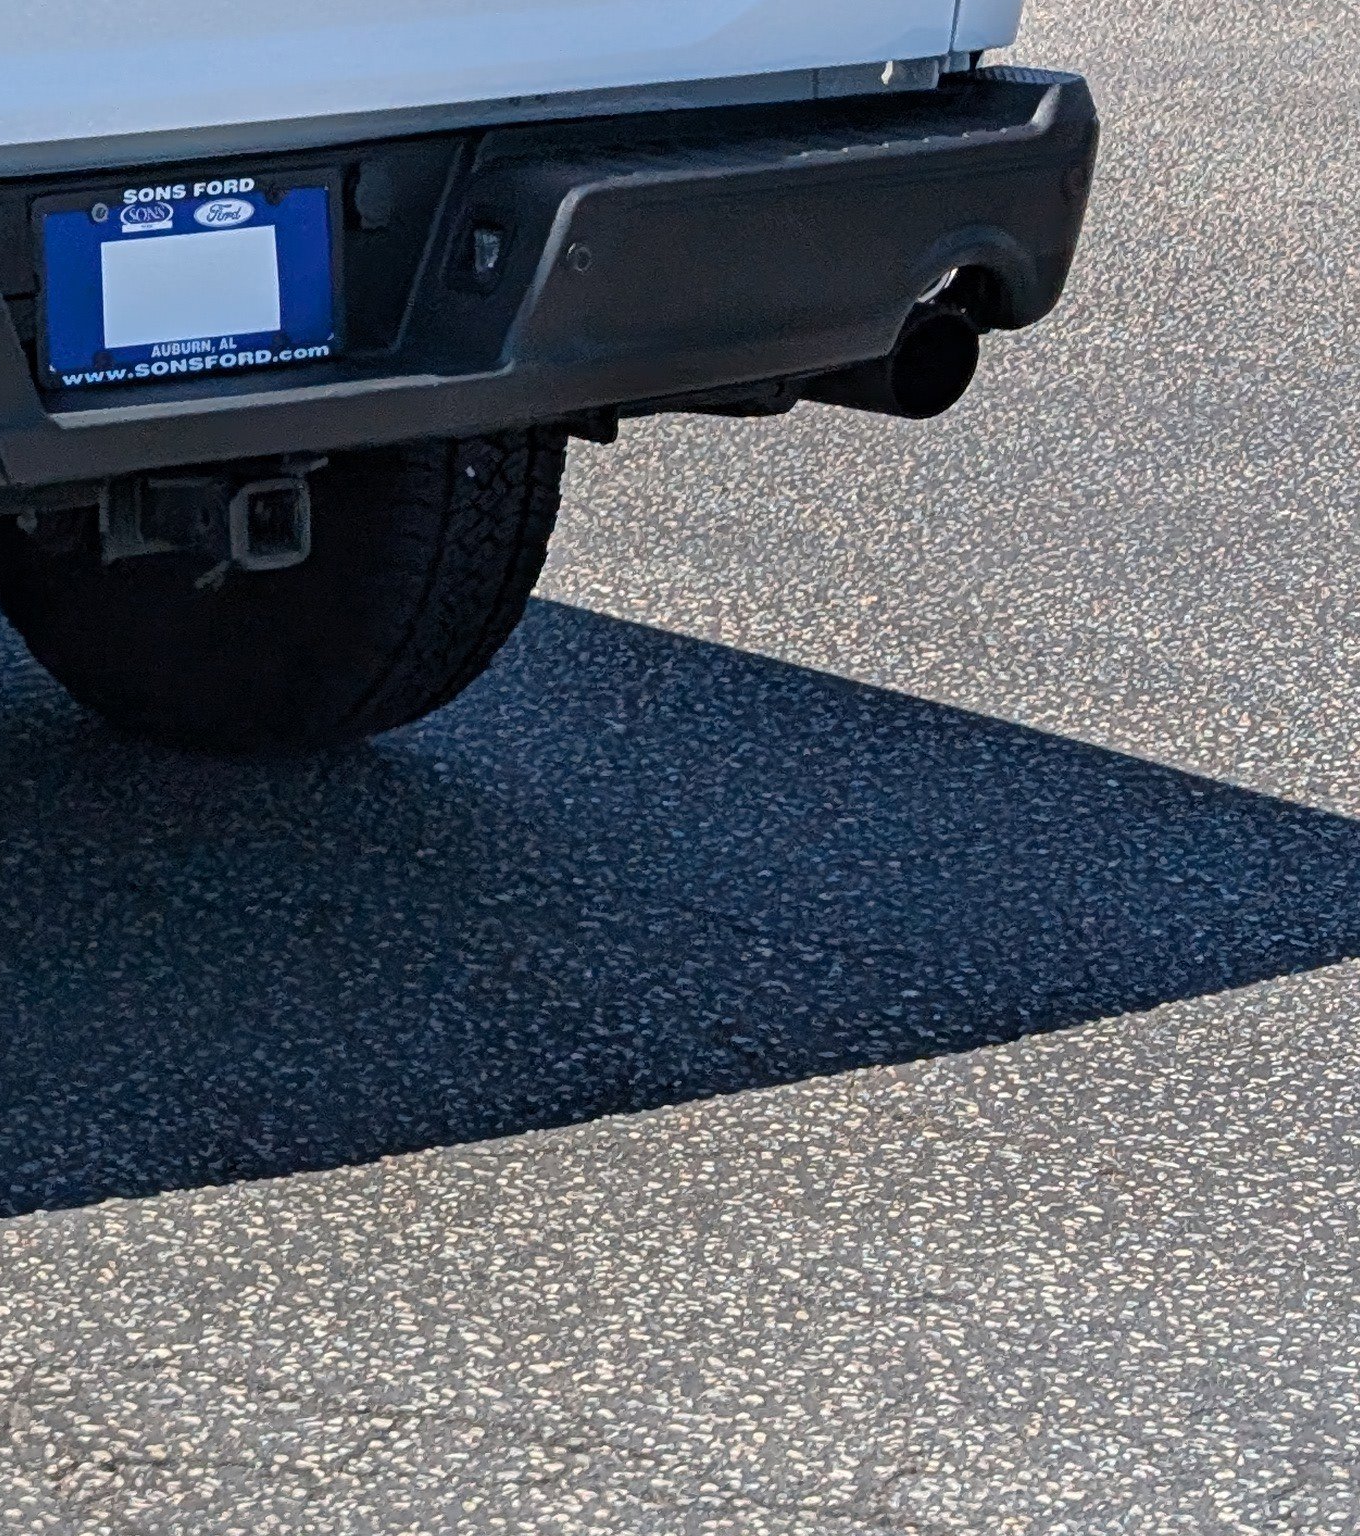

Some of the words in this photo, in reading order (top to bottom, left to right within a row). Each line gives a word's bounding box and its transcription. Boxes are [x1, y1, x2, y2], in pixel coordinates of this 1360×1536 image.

[123, 183, 186, 204] SONS
[193, 177, 255, 197] FORD
[129, 204, 166, 223] SONS
[206, 204, 242, 222] Ford
[152, 339, 215, 358] AUBURN,
[219, 337, 237, 350] AL
[62, 345, 330, 386] www.SONSFORD.com
